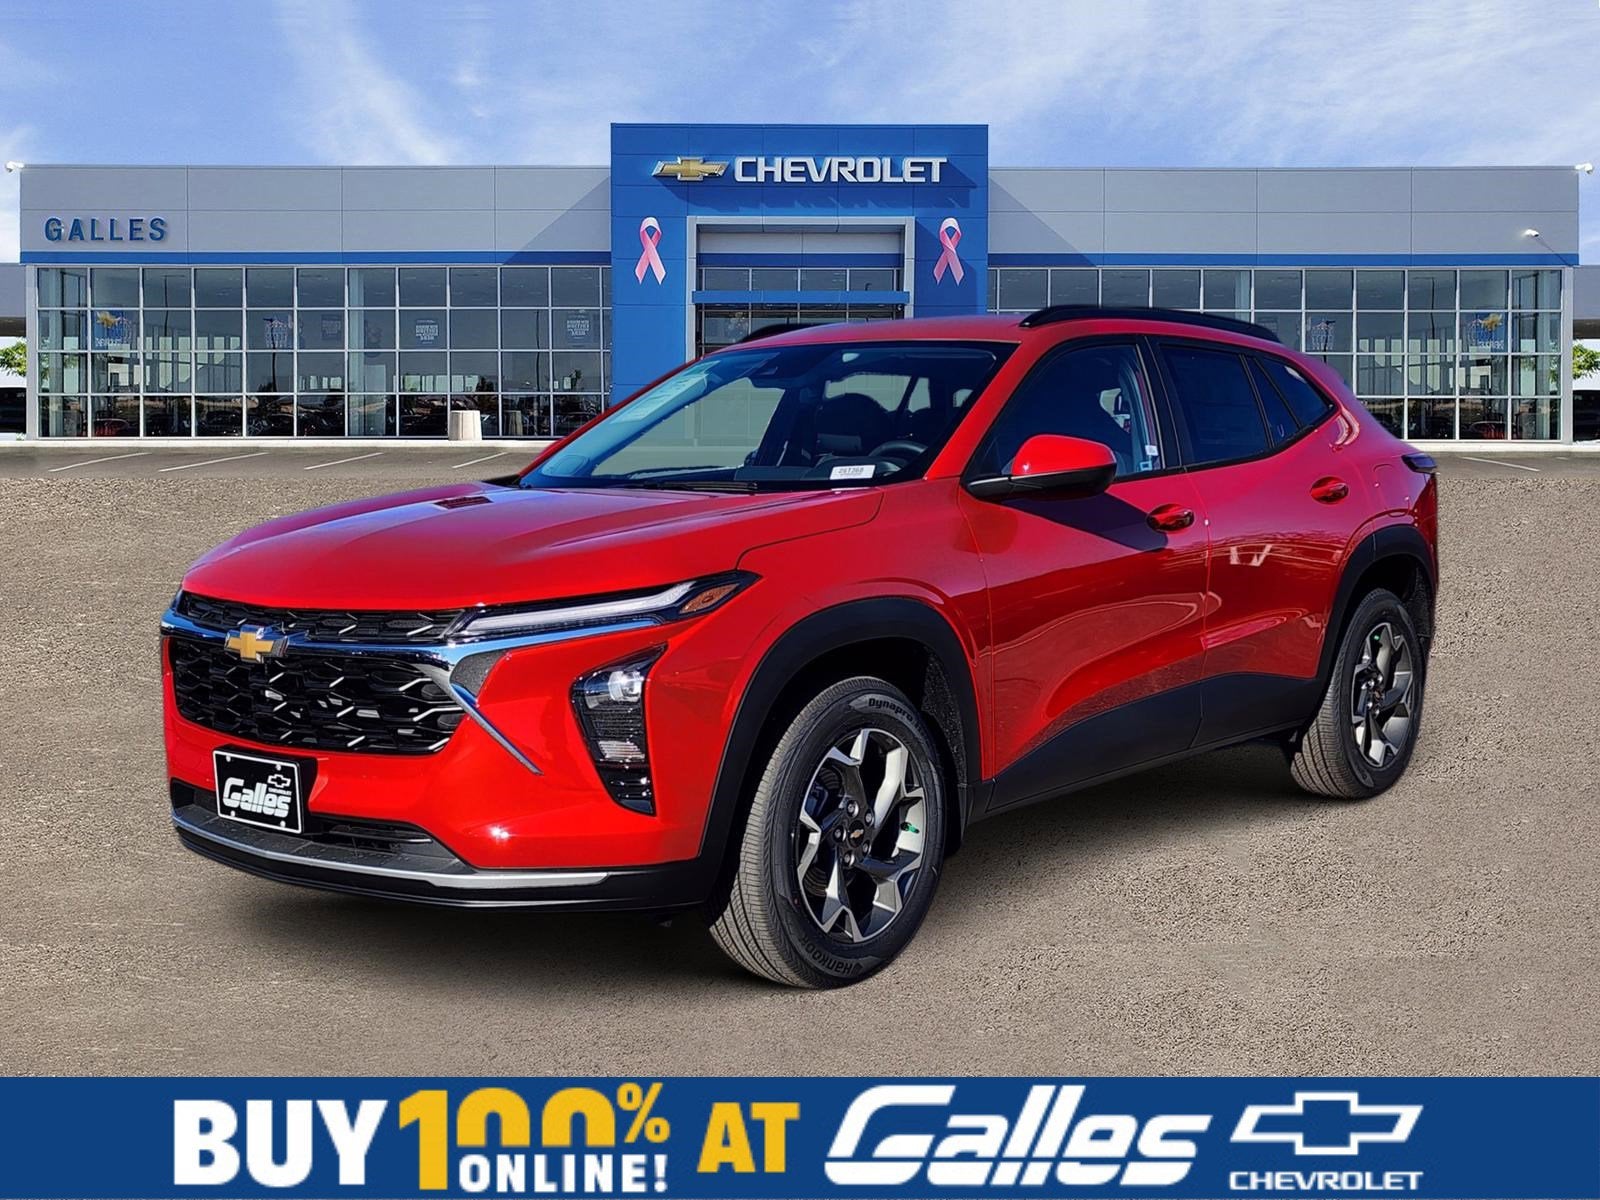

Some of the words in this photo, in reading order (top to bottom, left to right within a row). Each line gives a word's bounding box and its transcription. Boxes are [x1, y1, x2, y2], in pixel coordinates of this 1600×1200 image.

[735, 156, 948, 183] CHEVROLET
[44, 217, 166, 241] GALLES
[868, 697, 914, 722] Dynapro
[223, 777, 291, 818] Galles
